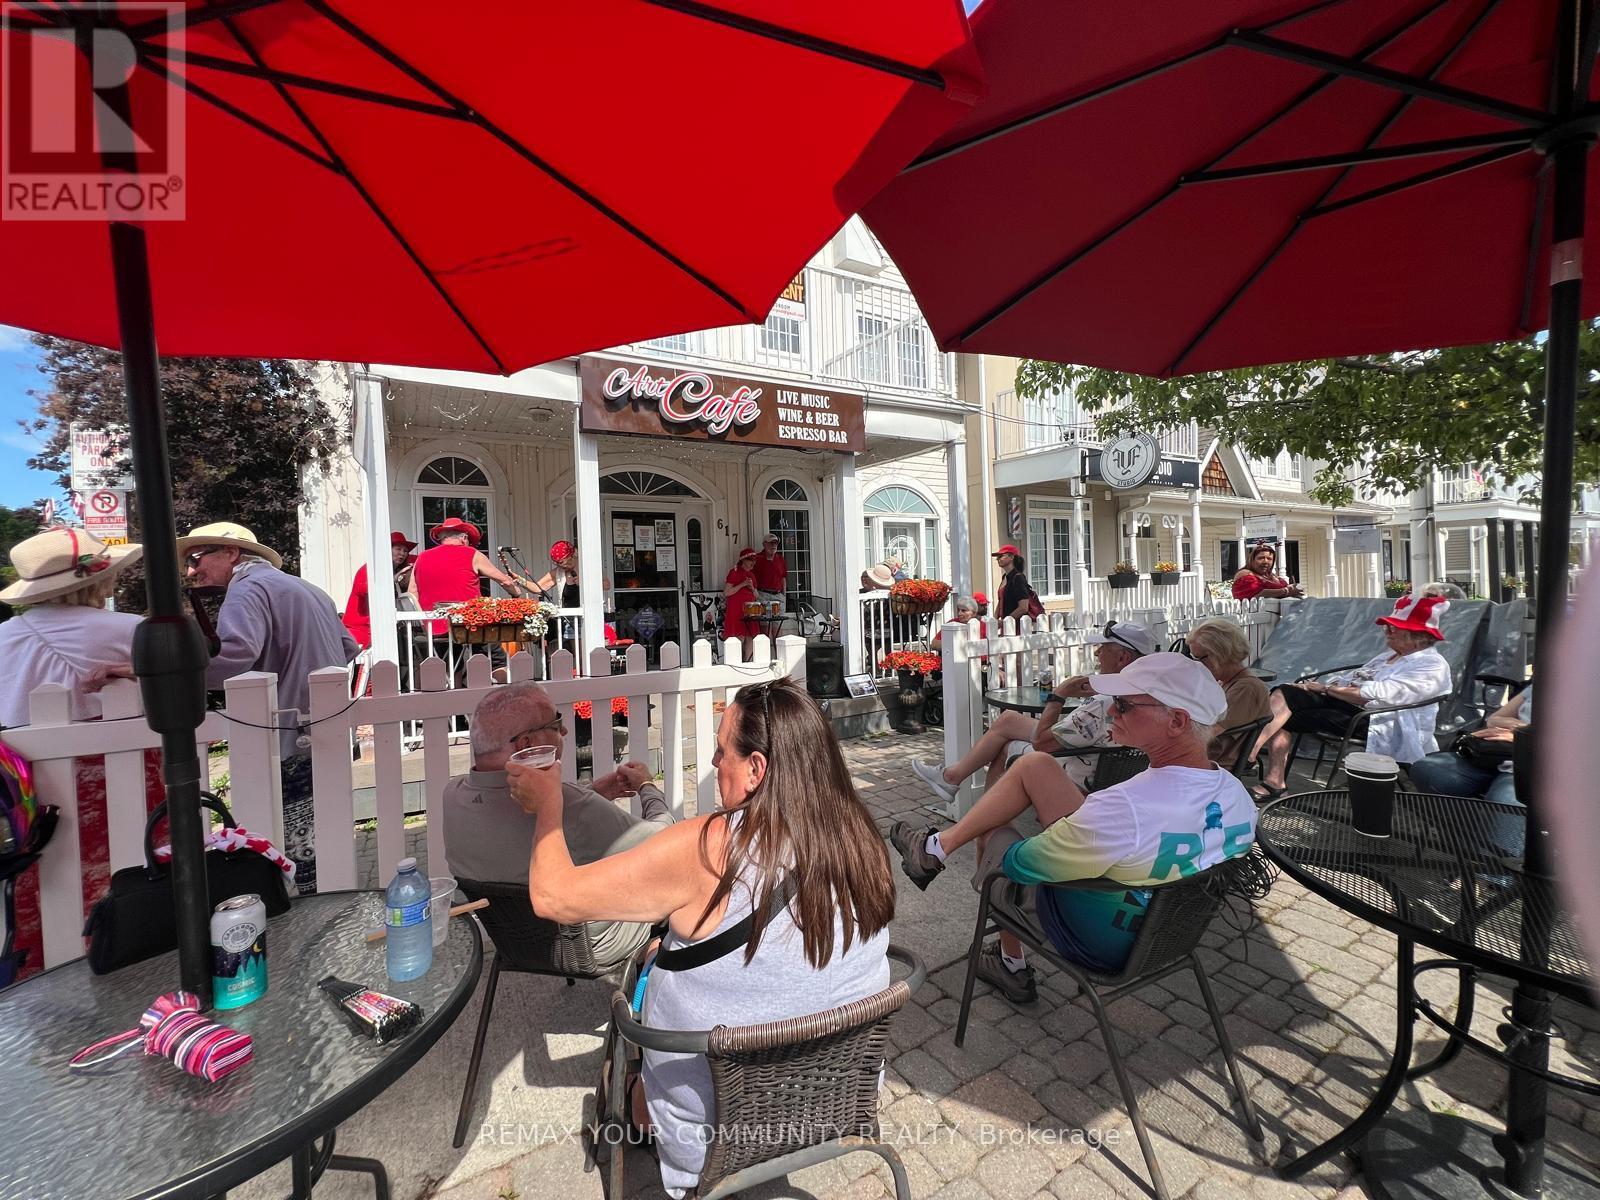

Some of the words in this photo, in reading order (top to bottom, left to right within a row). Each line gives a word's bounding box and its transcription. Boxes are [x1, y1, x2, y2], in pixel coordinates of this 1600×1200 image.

[604, 365, 671, 398] Art
[661, 372, 763, 434] Café
[777, 389, 799, 405] LIVE
[801, 393, 830, 409] MUSIC
[777, 408, 804, 423] WINE
[805, 411, 814, 424] &
[815, 412, 840, 427] BEER
[779, 425, 827, 442] ESPRESSO
[828, 430, 848, 444] BAR
